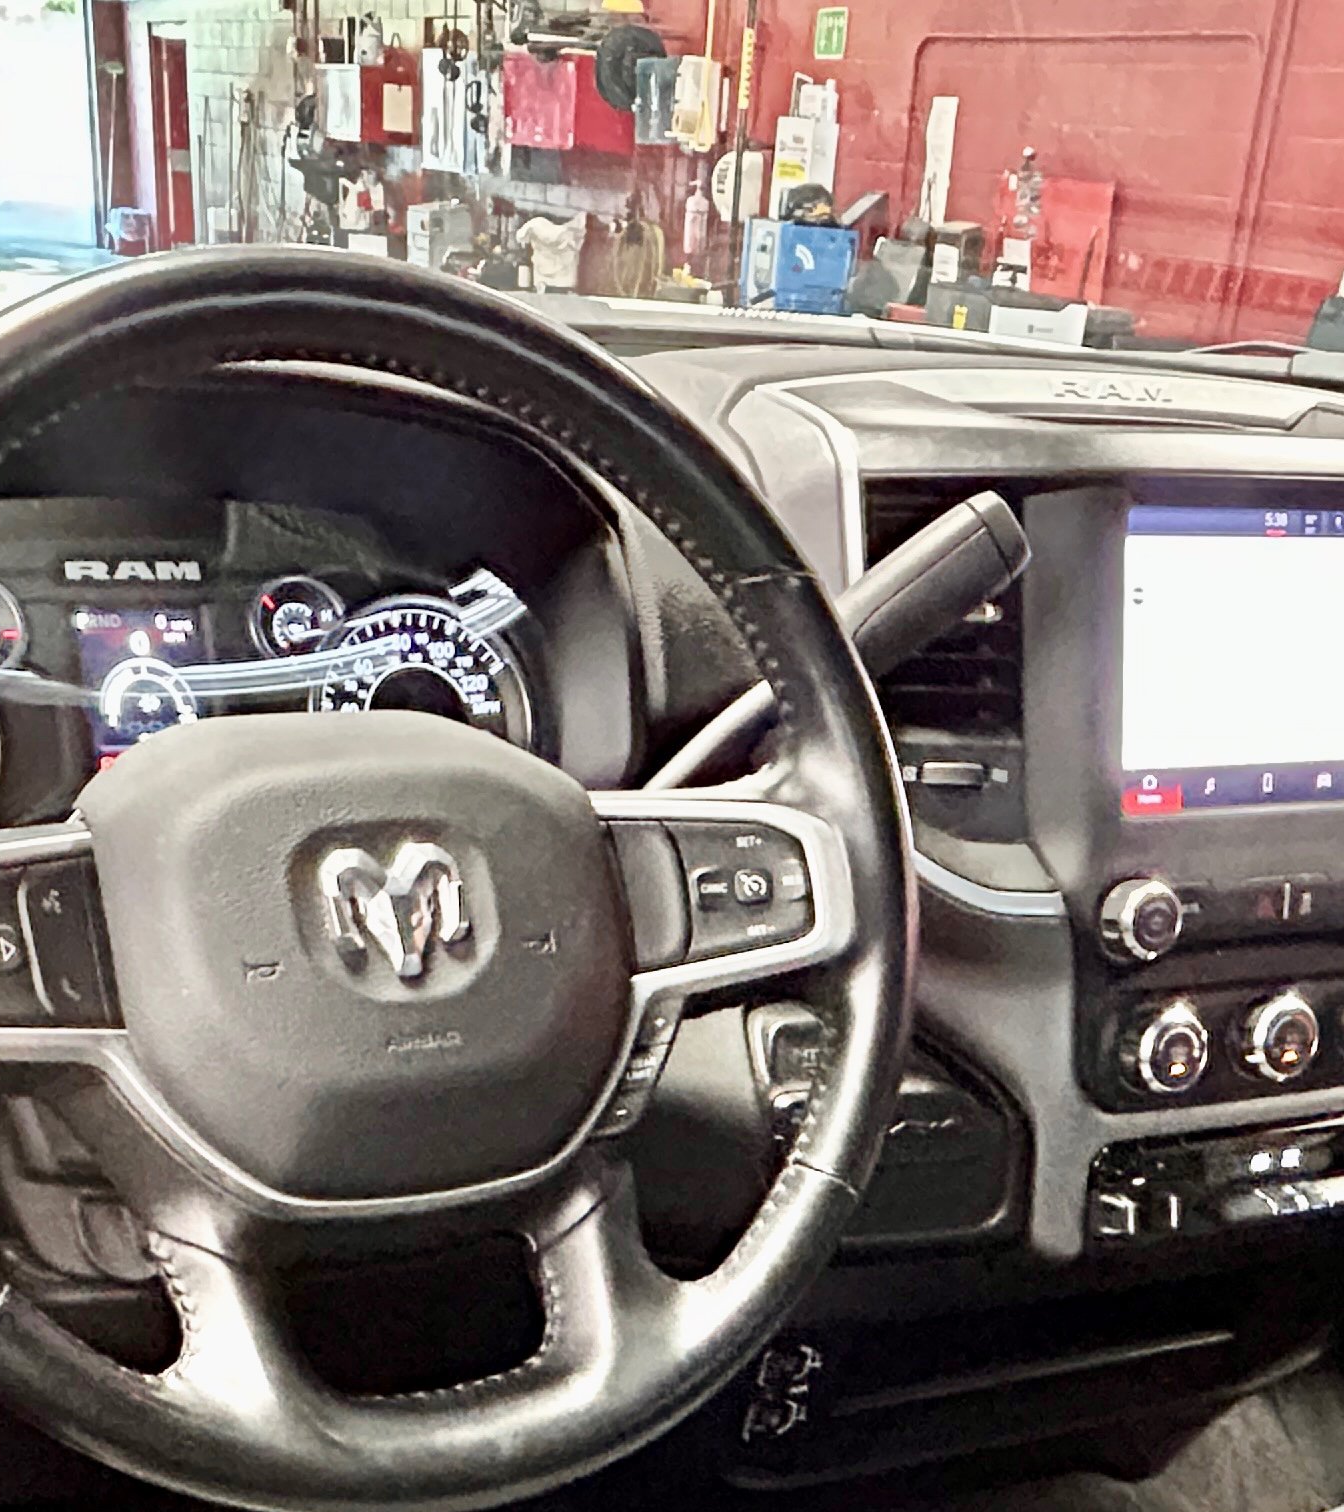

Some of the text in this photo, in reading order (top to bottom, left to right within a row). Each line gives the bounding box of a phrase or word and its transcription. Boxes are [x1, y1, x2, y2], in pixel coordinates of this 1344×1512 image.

[1054, 382, 1173, 403] RAM
[64, 560, 202, 582] RAM
[427, 641, 455, 659] 100
[460, 675, 488, 691] 120
